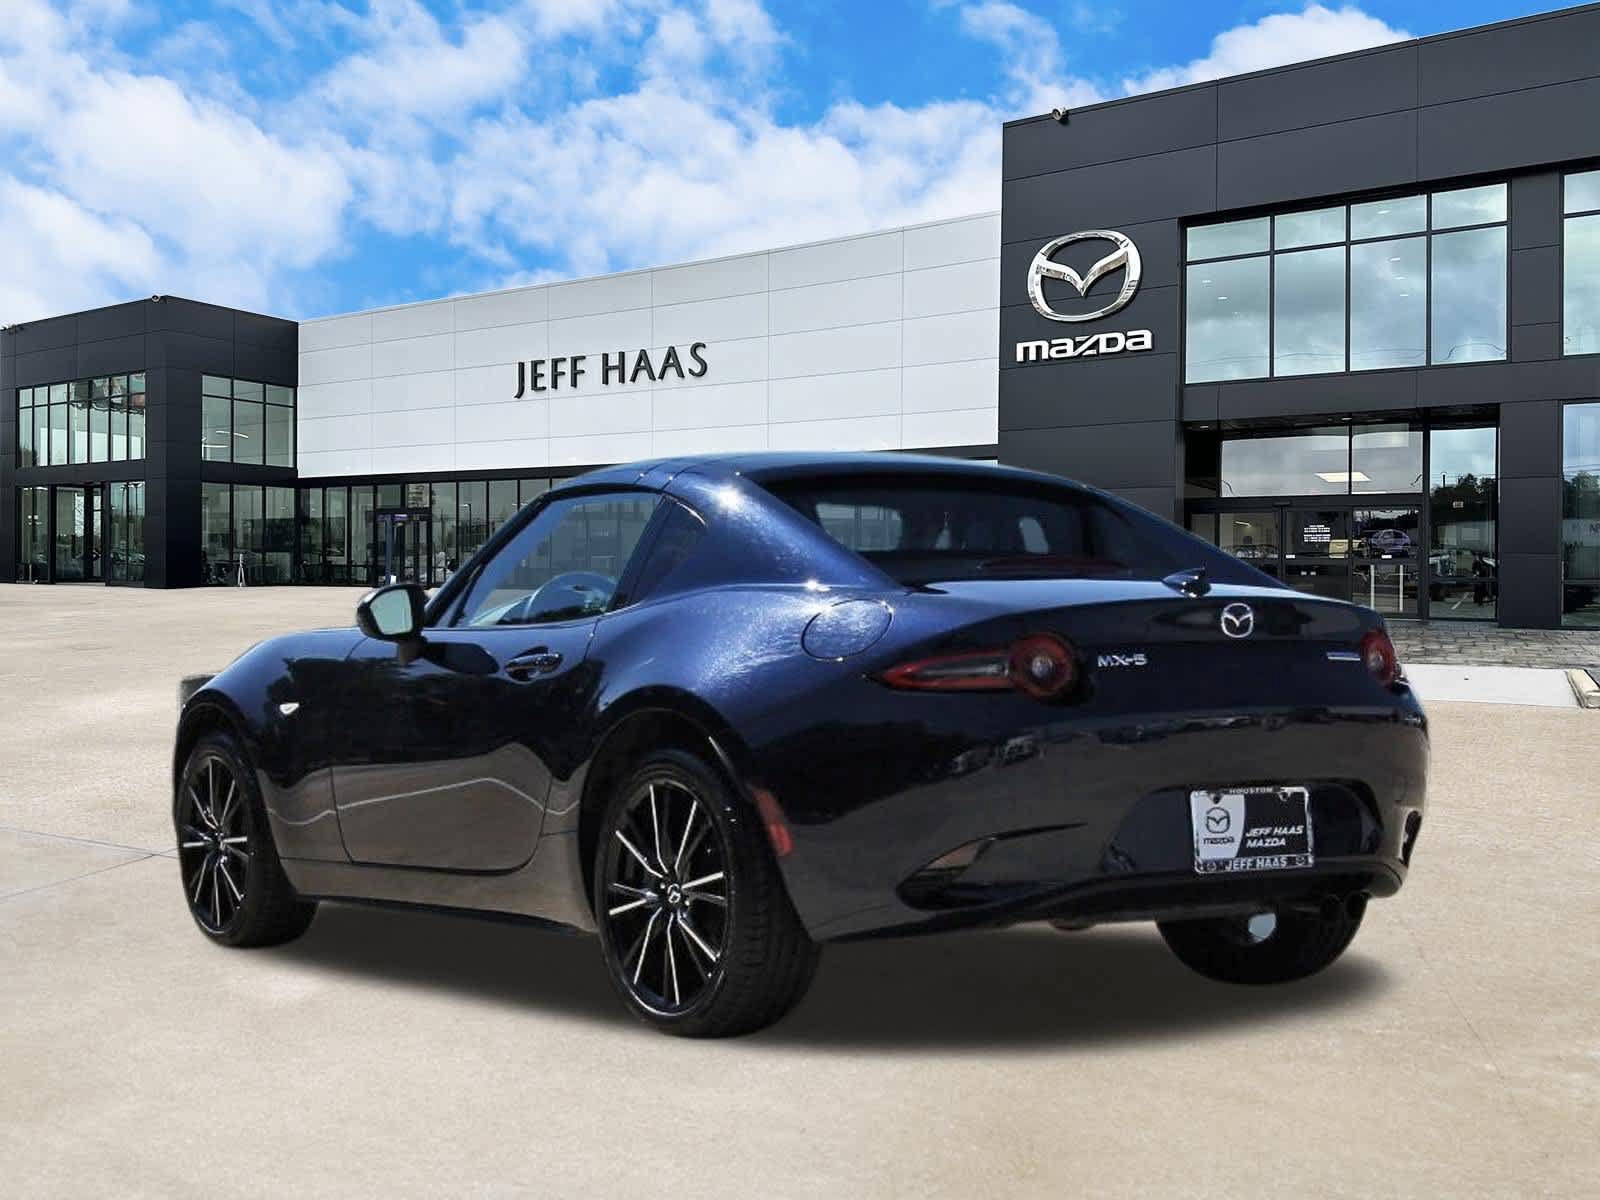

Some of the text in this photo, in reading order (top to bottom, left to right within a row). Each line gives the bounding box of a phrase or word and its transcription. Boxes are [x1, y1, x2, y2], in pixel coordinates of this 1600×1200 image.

[514, 342, 708, 399] JEFF HAAS
[1097, 653, 1148, 667] MX-5
[1229, 786, 1273, 795] HOUSTON
[1245, 825, 1304, 838] JEFF HAAS
[1246, 837, 1287, 849] MAZDA
[1225, 856, 1287, 871] JEFF HAAS
